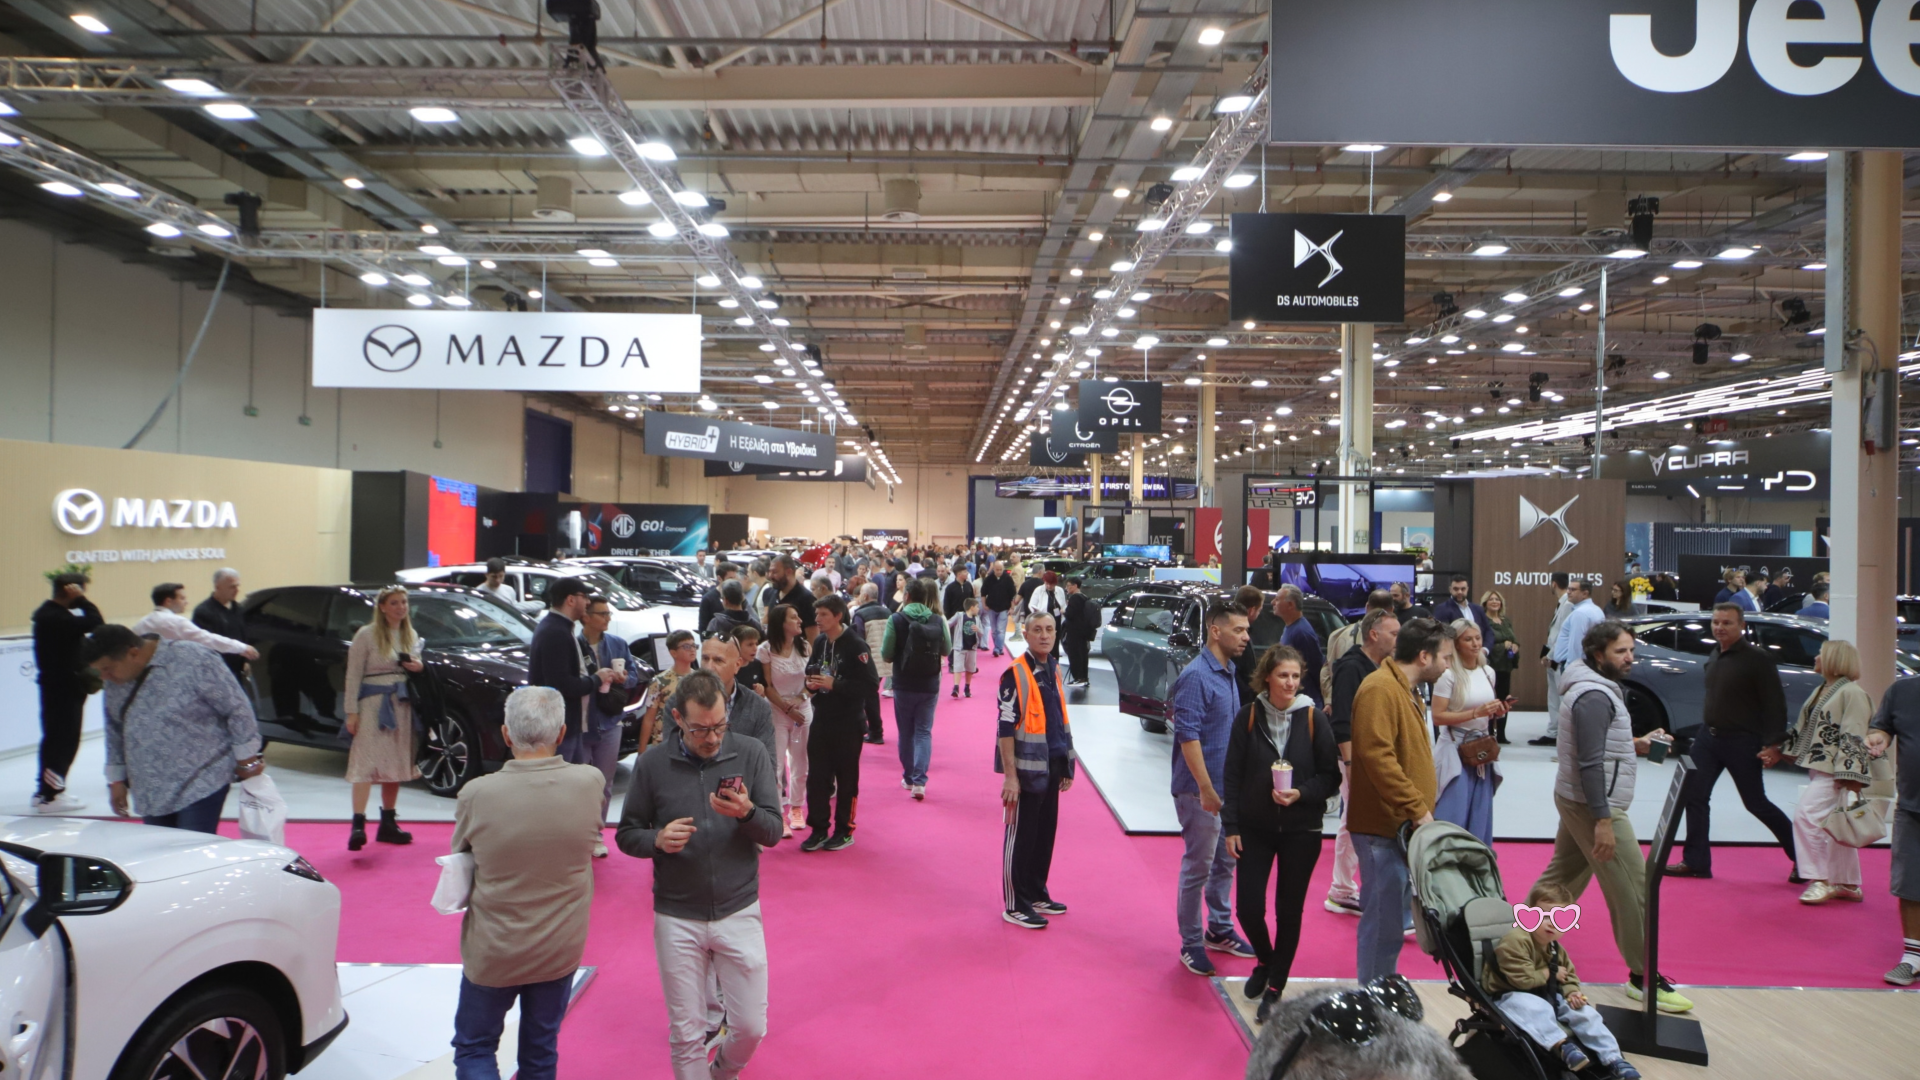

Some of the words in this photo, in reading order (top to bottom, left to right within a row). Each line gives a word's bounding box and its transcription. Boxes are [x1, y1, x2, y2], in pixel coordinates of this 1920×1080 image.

[1277, 294, 1290, 306] DS
[1292, 294, 1359, 307] AUTOMOBILES
[446, 334, 650, 369] MAZDA
[1098, 417, 1141, 427] OPEL
[739, 436, 770, 455] Εξέλιξη
[770, 442, 785, 454] στα
[785, 441, 817, 457] Υβριδικά
[1668, 450, 1749, 471] CUPRA
[111, 497, 238, 528] MAZDA
[612, 515, 634, 537] MG
[640, 520, 665, 532] GO!
[65, 551, 119, 563] CRAFTED
[121, 549, 150, 561] WITH
[150, 548, 200, 562] JAPANESE
[200, 547, 226, 559] SOUL
[611, 548, 634, 556] DRIVE
[1494, 571, 1512, 585] DS
